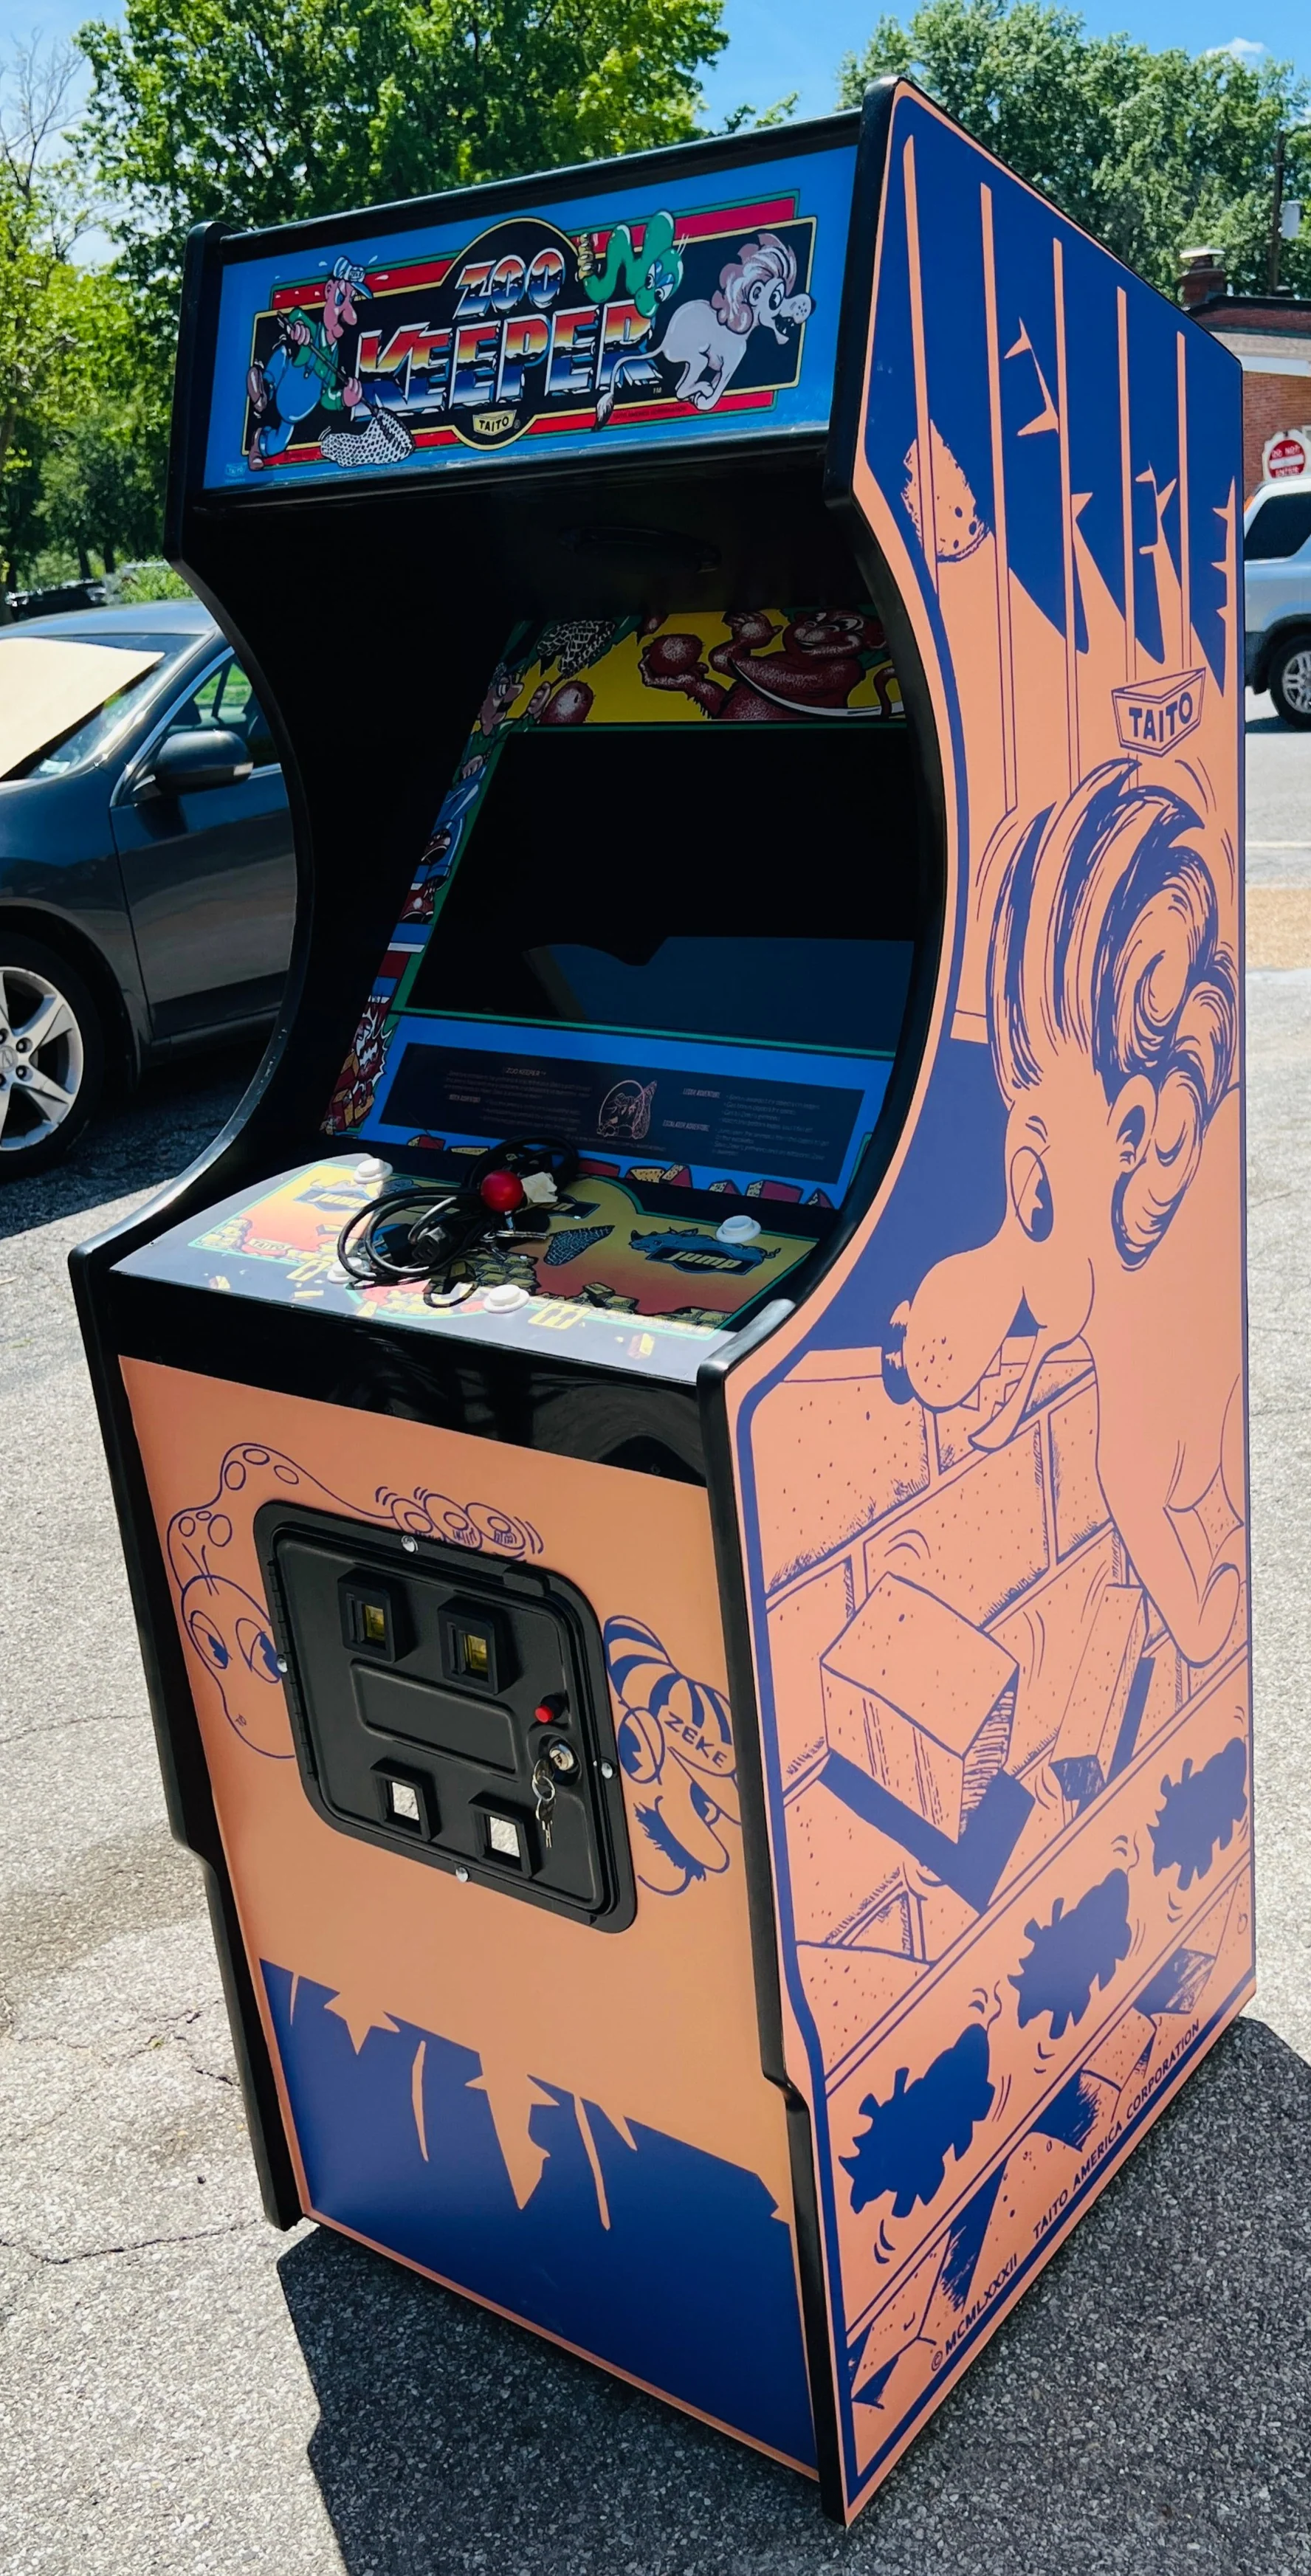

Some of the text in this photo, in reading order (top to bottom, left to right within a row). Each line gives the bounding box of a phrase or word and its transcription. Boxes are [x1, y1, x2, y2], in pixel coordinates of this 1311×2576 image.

[452, 247, 566, 320] ZOO
[351, 300, 663, 422] KEEPER
[479, 416, 509, 432] TAITO
[1284, 444, 1300, 455] NOT
[1129, 692, 1192, 742] TAITO
[663, 1251, 743, 1269] jump
[664, 1711, 727, 1769] ZEKE
[944, 2253, 1018, 2357] MCMLXXXII
[1033, 2189, 1069, 2241] TAITO
[1073, 2124, 1123, 2192] AMERICA
[1126, 2019, 1200, 2120] CORPORATION
